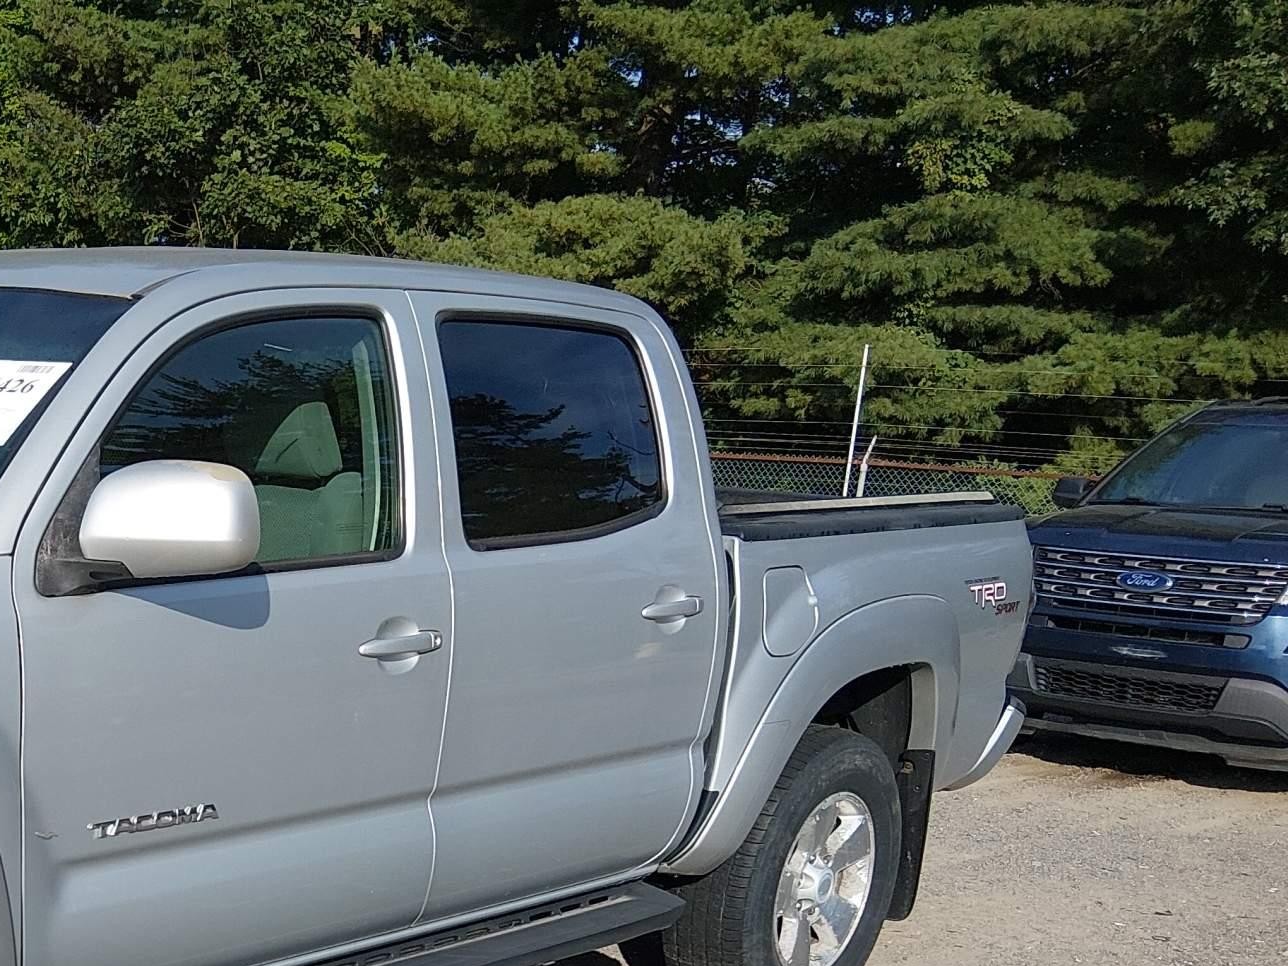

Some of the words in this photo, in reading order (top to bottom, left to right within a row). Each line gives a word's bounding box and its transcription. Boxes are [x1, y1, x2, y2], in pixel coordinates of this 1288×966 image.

[1126, 573, 1160, 587] Ford
[968, 581, 1007, 610] TRD
[995, 600, 1021, 616] SPORT
[86, 803, 219, 839] TACOMA
